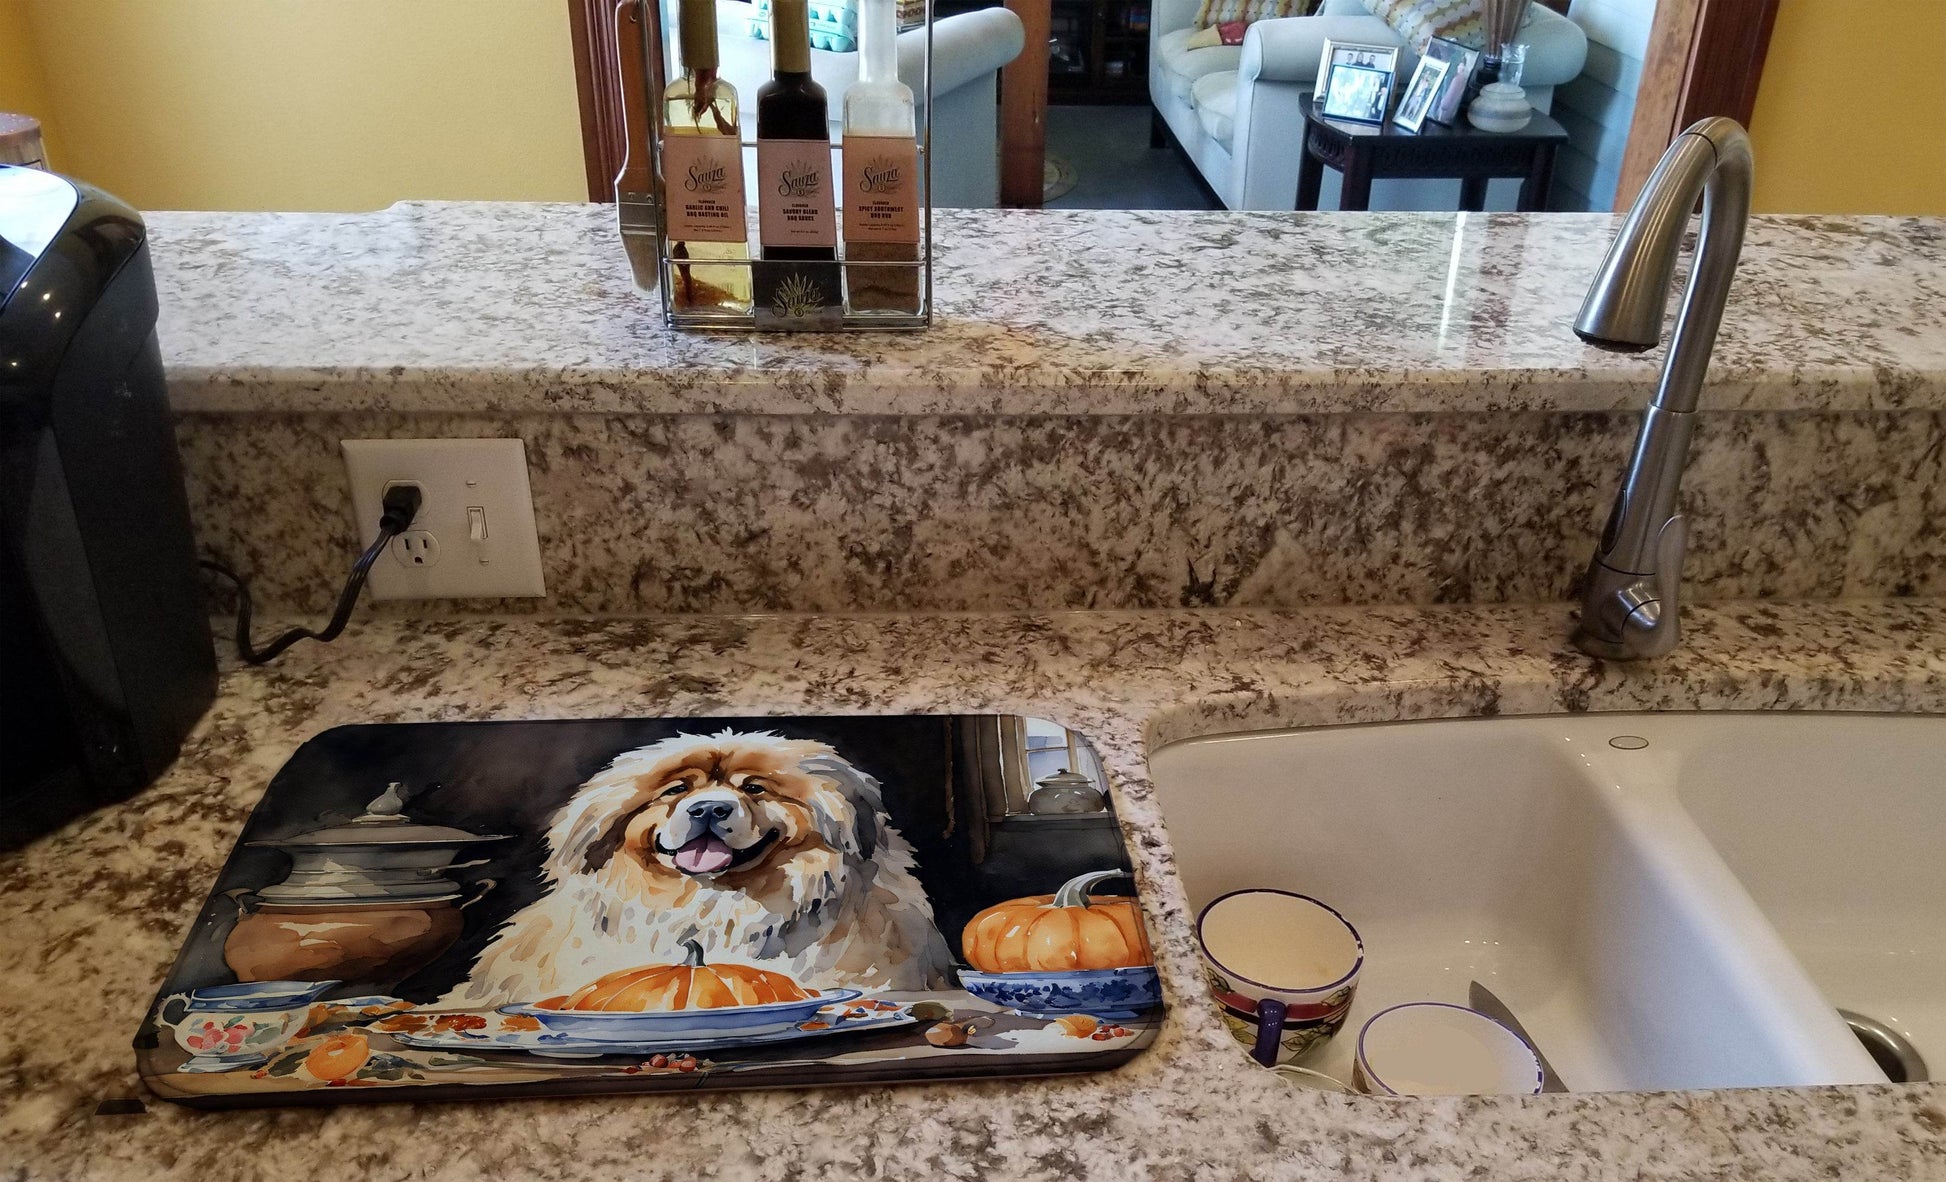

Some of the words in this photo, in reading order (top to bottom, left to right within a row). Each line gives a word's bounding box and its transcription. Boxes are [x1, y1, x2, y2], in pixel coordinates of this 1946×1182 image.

[685, 165, 726, 191] Sauza
[778, 170, 819, 197] Sauza
[860, 166, 900, 192] Sauza
[771, 287, 824, 318] Sauza
